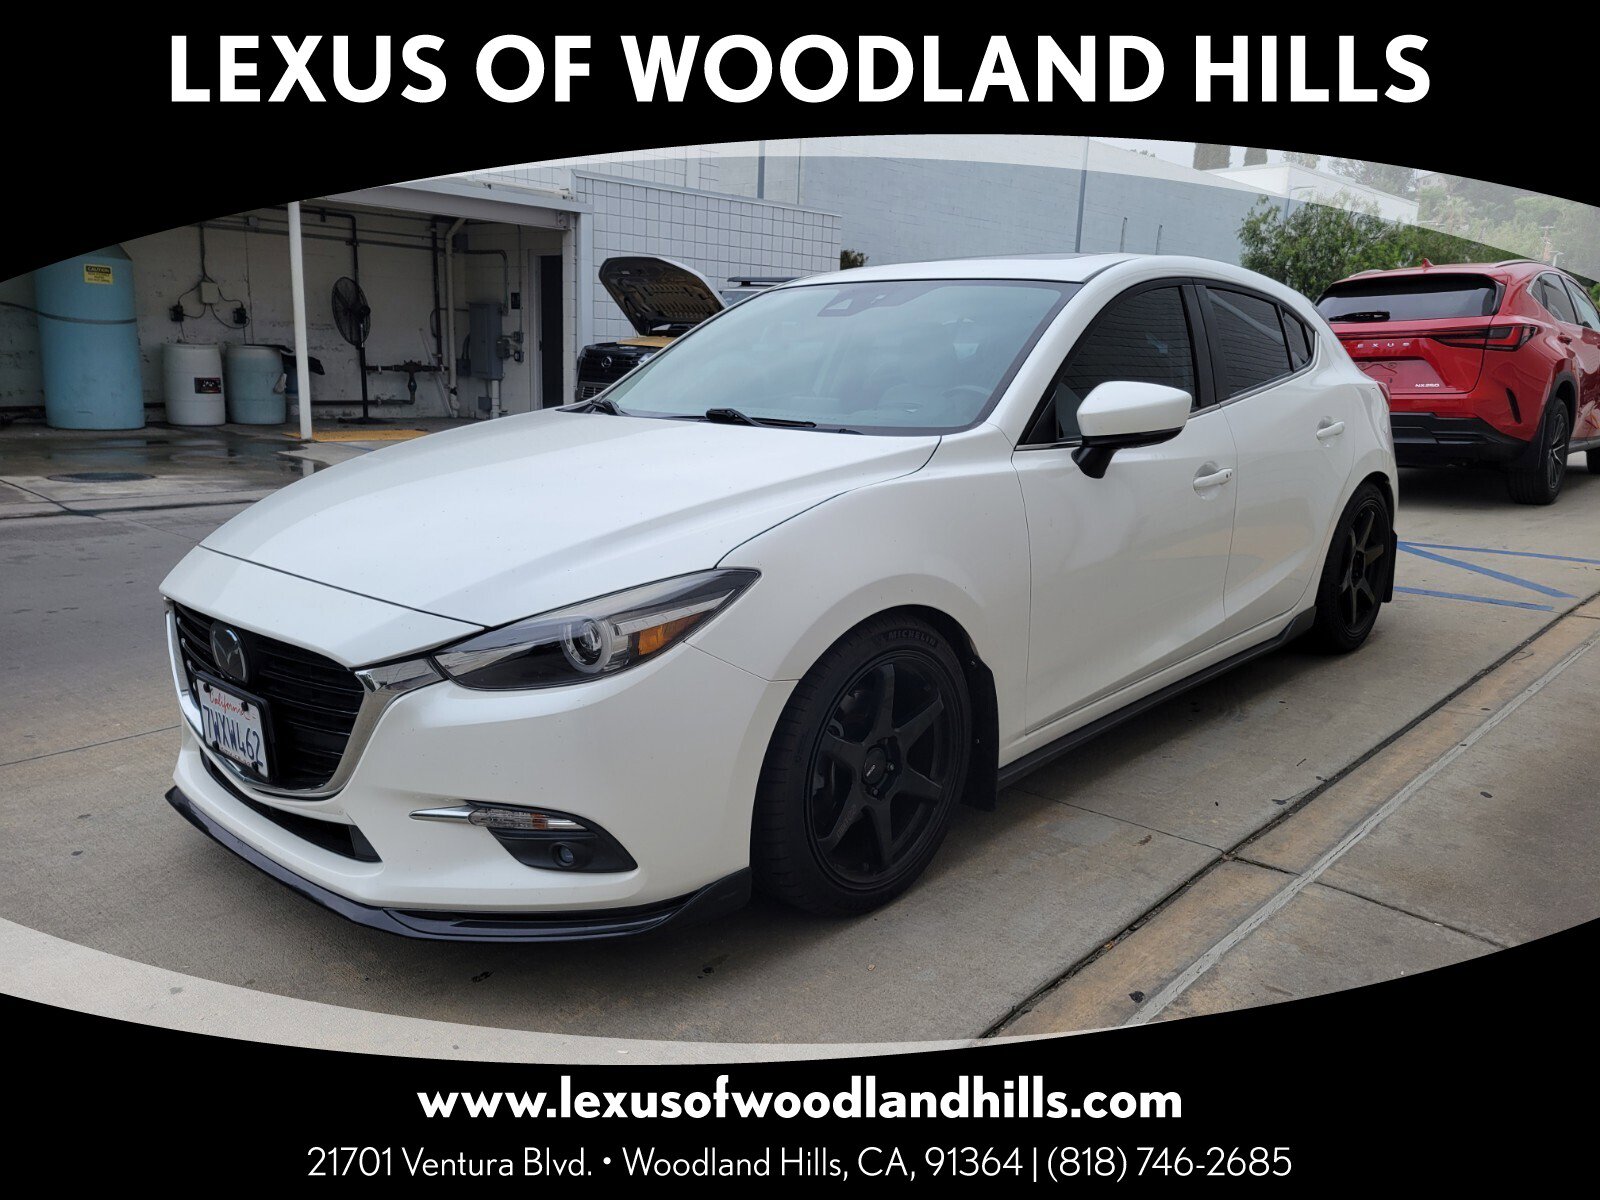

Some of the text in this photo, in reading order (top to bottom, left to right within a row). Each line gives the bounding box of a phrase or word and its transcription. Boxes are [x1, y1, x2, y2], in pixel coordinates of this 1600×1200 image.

[888, 629, 936, 645] MICHELIN
[210, 690, 251, 720] California
[202, 704, 264, 767] 7WXW462
